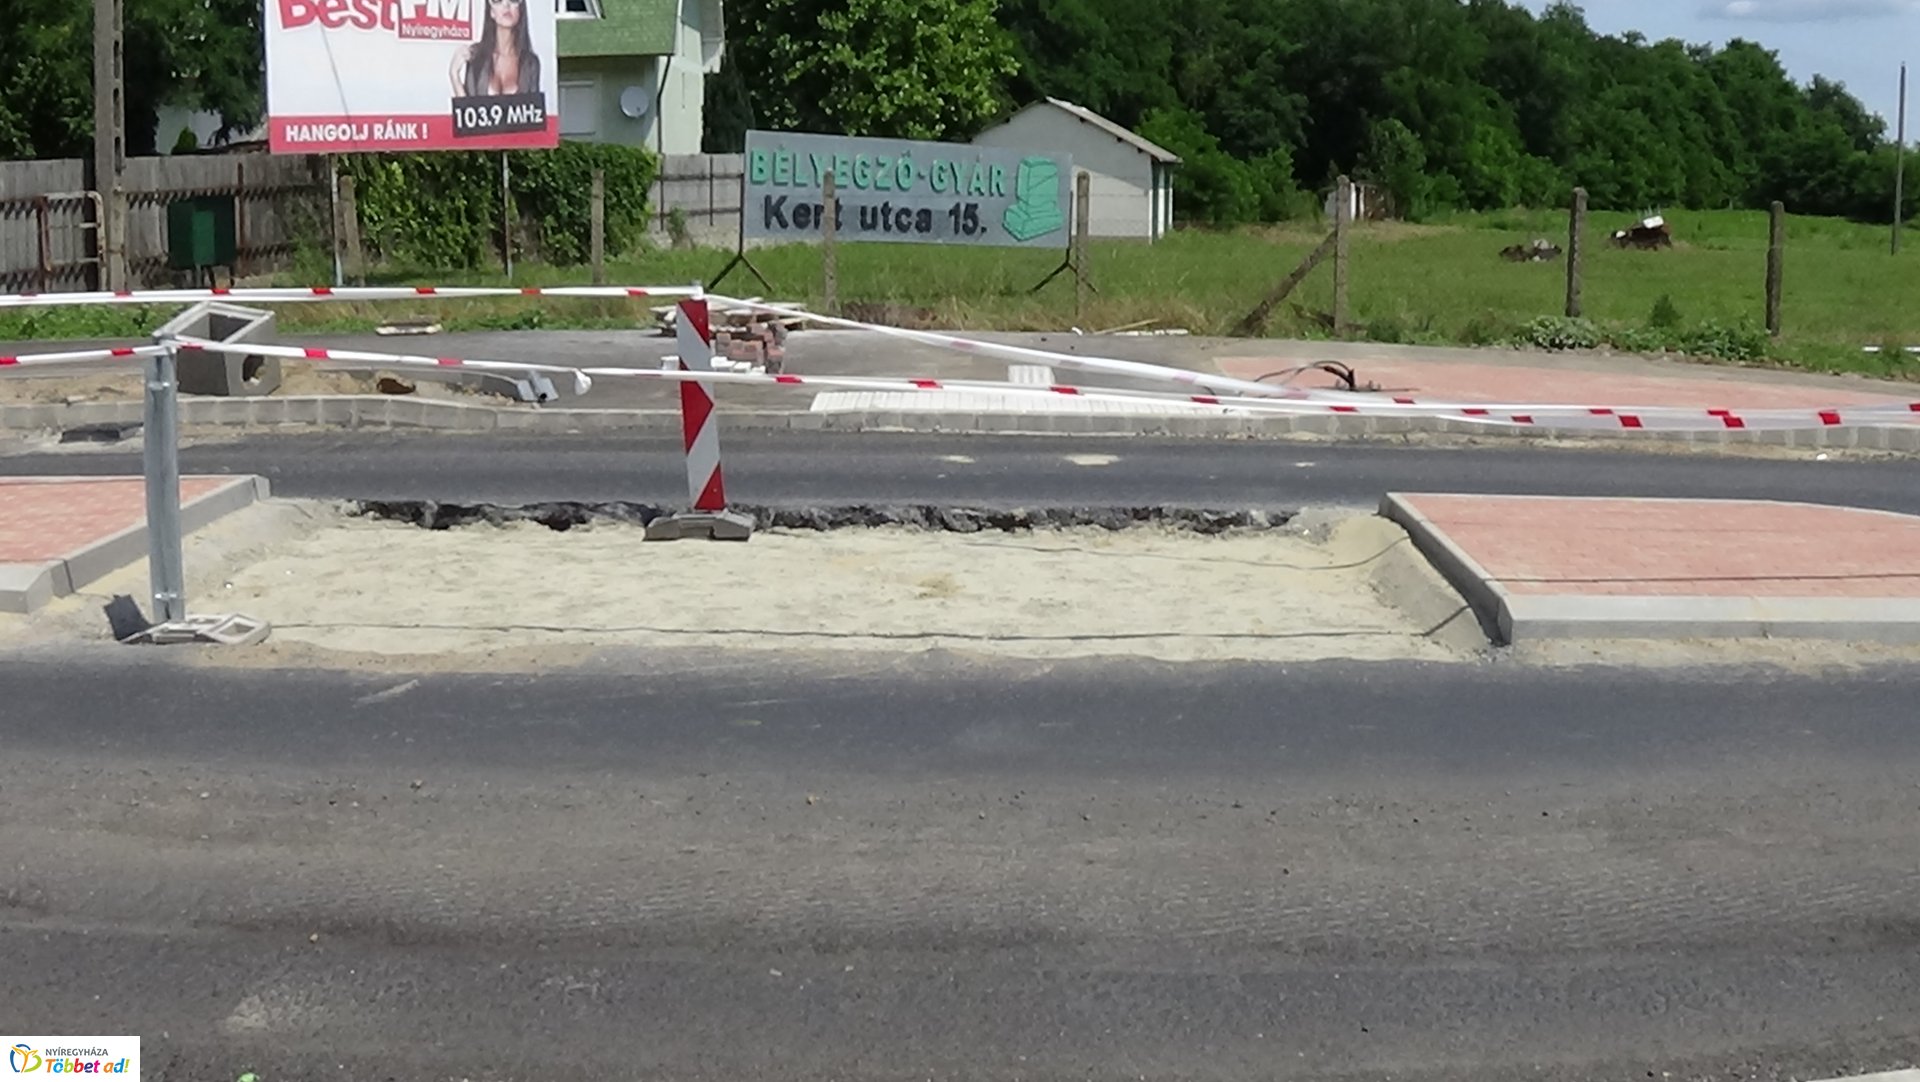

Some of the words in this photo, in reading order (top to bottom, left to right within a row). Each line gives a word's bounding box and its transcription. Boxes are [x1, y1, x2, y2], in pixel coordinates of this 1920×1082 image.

[402, 23, 469, 38] Nyíregyháza
[455, 106, 502, 128] 103.9
[507, 103, 543, 124] MHz
[286, 123, 368, 142] HANGOLJ
[374, 119, 418, 140] RÁNK
[751, 146, 1005, 197] BÉLYEGZŐ-GYÁR
[860, 201, 932, 234] utca
[949, 203, 987, 235] 15.
